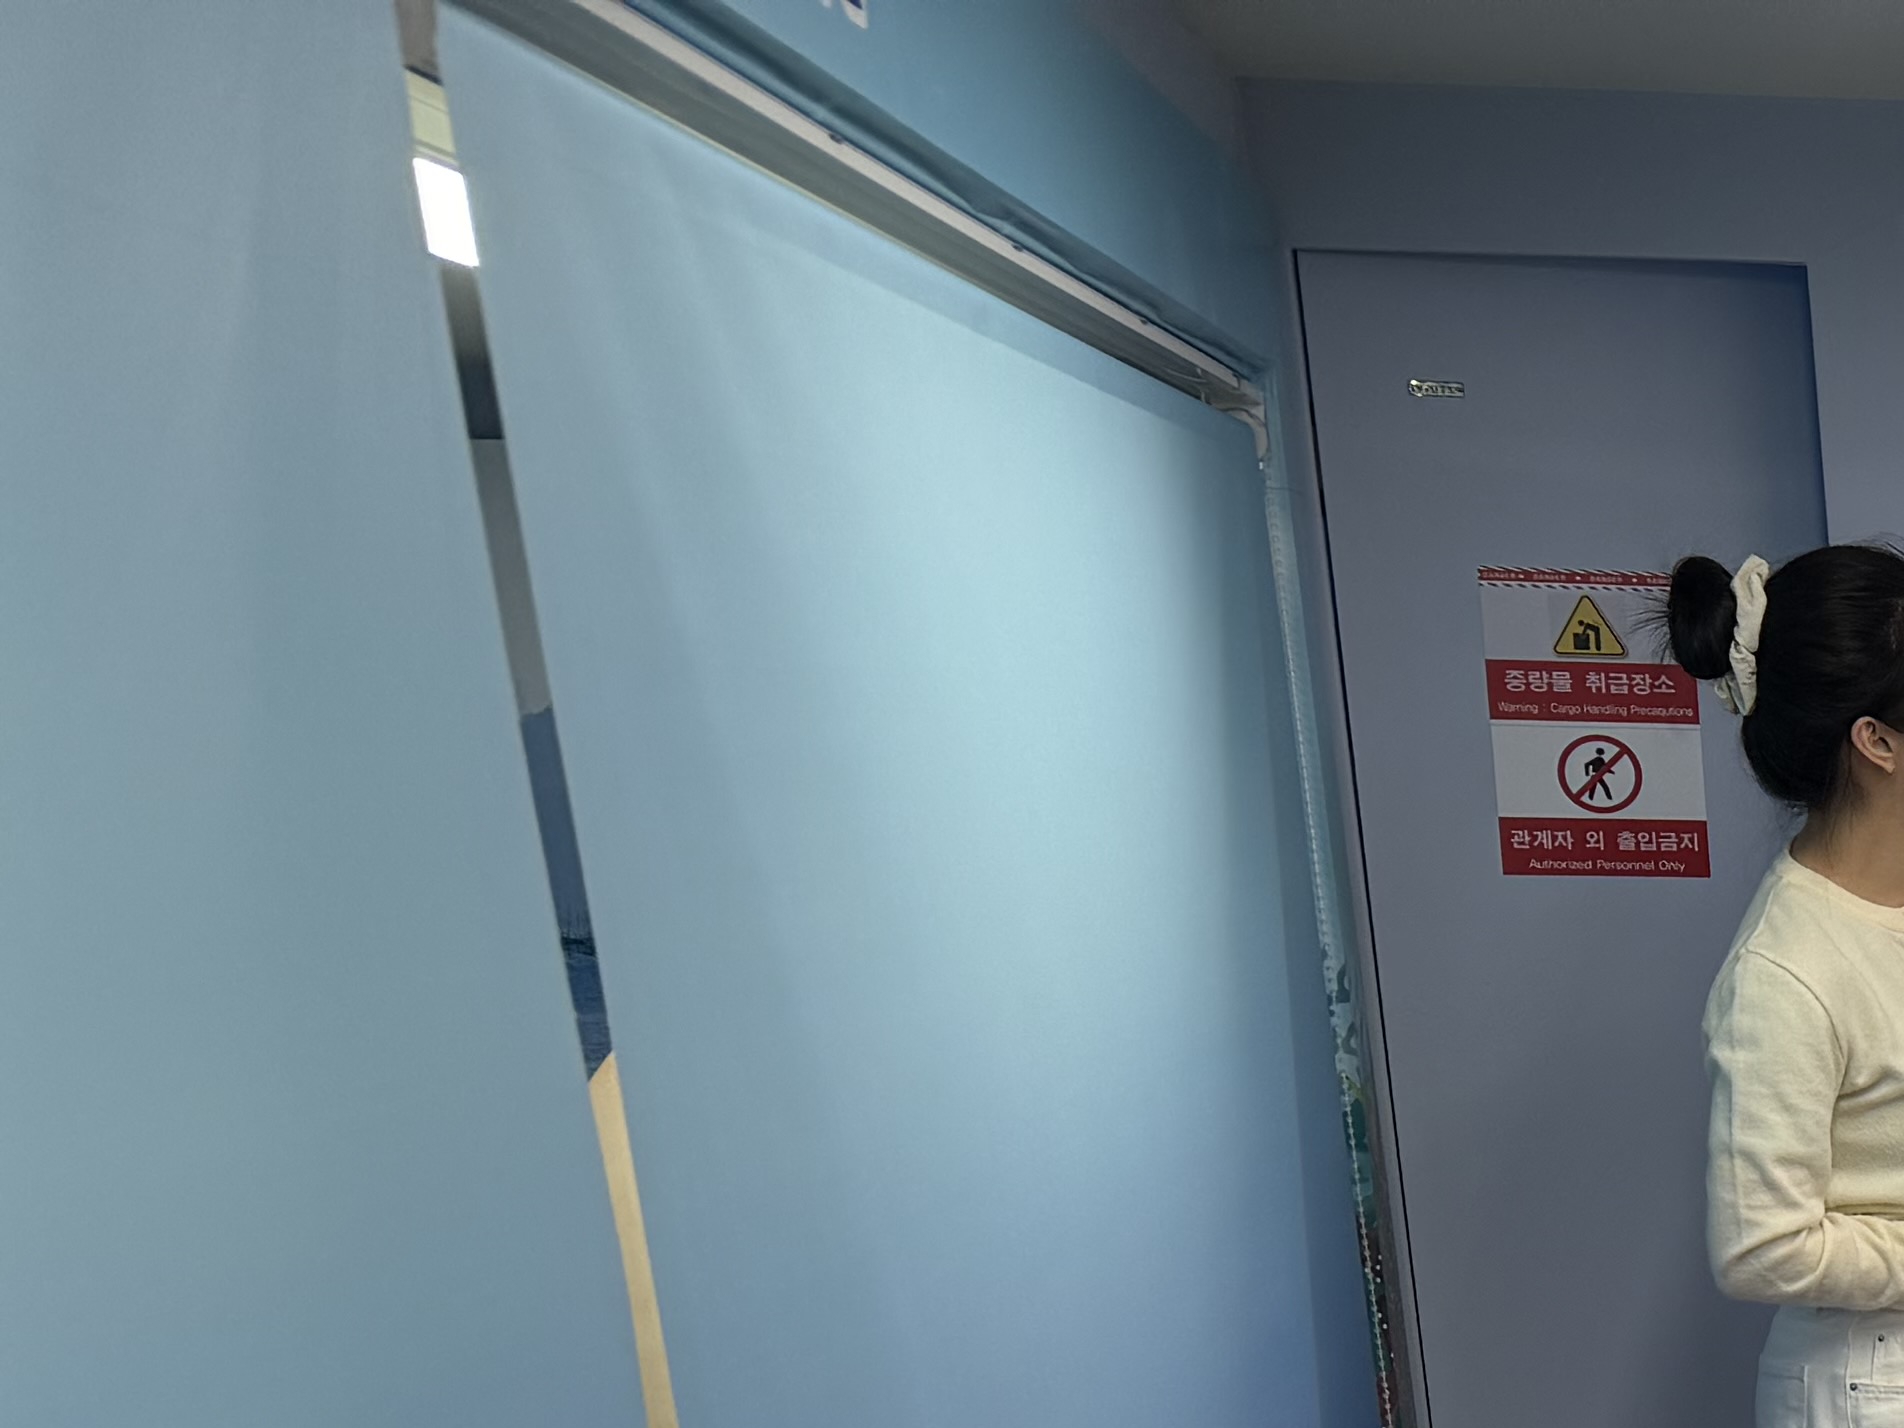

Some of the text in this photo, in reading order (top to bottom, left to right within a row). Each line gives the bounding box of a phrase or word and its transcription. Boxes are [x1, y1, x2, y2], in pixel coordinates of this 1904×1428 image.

[1505, 670, 1676, 694] 중량물 취급장소
[1498, 702, 1538, 714] Warning
[1551, 703, 1580, 714] Cargo
[1584, 704, 1627, 717] Handling
[1511, 830, 1699, 851] 관계자 외 출입금지
[1529, 859, 1685, 872] Authorized Personnel Only
